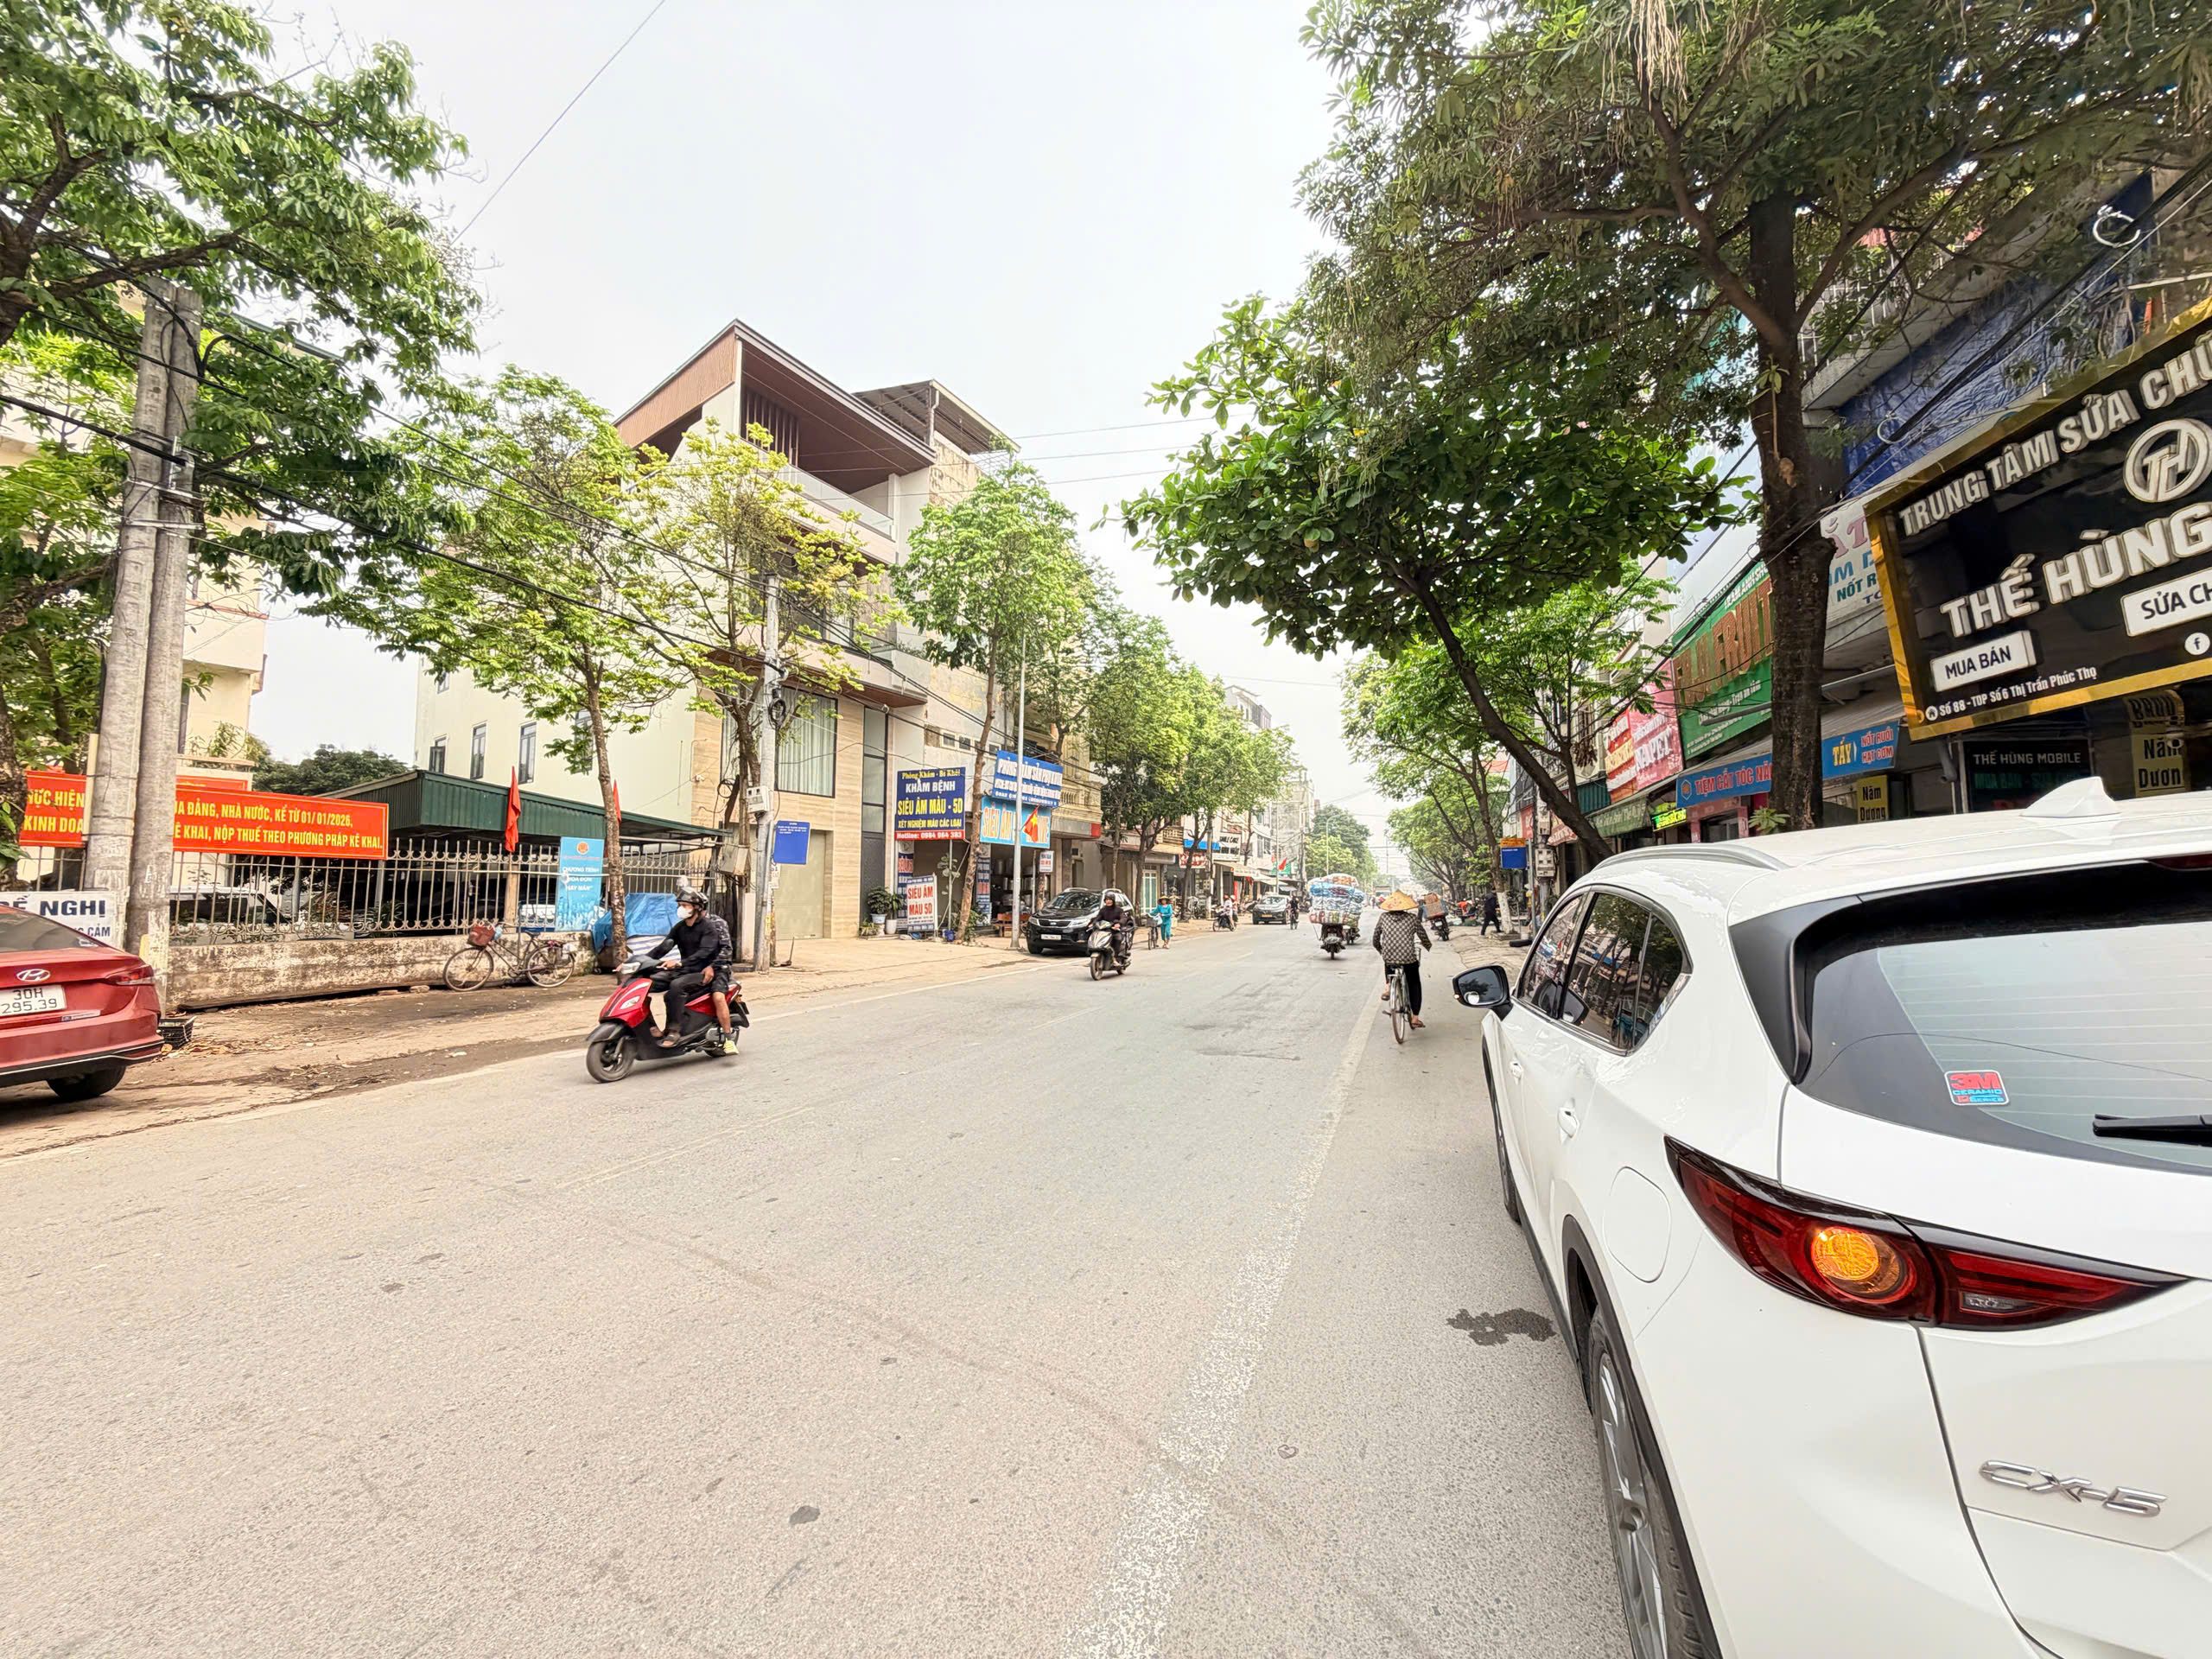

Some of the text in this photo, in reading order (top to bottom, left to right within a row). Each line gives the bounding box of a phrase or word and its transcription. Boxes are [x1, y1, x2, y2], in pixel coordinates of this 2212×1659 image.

[1899, 469, 1990, 536] TRUNG
[1986, 429, 2060, 493] TÂM
[2060, 389, 2141, 454] SỬA
[1941, 501, 2212, 639] THẾ HÙNG
[1836, 578, 1864, 602] NỐT
[2140, 582, 2212, 620] SỬA CH
[1711, 574, 1773, 691] FRUIT
[1944, 645, 2012, 680] MUA BÁN
[1939, 702, 1952, 717] Số
[1953, 701, 1966, 714] 88
[1971, 694, 1988, 707] TDP
[1990, 687, 2002, 702] Số
[2001, 688, 2009, 699] 6
[2009, 683, 2026, 697] Thị
[2025, 677, 2050, 694] Trấn
[2050, 670, 2075, 689] Phúc
[2075, 666, 2097, 681] Thọ
[1973, 749, 2082, 765] THẾ HÙNG MOBILE
[932, 779, 956, 794] BỆNH
[1694, 778, 1715, 798] TIỆM
[1735, 766, 1754, 786] TÓC
[1756, 760, 1772, 782] NĂ
[2139, 767, 2182, 789] Dươn
[54, 789, 85, 810] HIỆN
[1862, 785, 1882, 801] Năm
[187, 798, 219, 819] ĐẢNG,
[221, 802, 242, 819] NHÀ
[243, 804, 273, 823] NƯỚC,
[289, 808, 301, 823] TỪ
[898, 797, 914, 816] SIÊU
[915, 797, 928, 815] ÂM
[929, 795, 946, 815] MÀU
[952, 798, 963, 814] 5D
[23, 815, 84, 834] KINH DOA
[183, 825, 212, 842] KHAI,
[213, 824, 235, 844] NỘP
[237, 823, 261, 843] THUẾ
[263, 830, 286, 844] THEO
[288, 831, 324, 847] PHƯƠNG
[325, 830, 347, 848] PHÁP
[361, 836, 384, 849] KHAI.
[907, 885, 933, 899] SIÊU ÂM
[40, 899, 106, 918] NGHỊ
[908, 901, 932, 916] MÀU 5D
[12, 987, 44, 1001] 30H
[0, 998, 58, 1014] 295.39
[1949, 1071, 2001, 1090] 3M
[1979, 1459, 2167, 1517] CX-5
